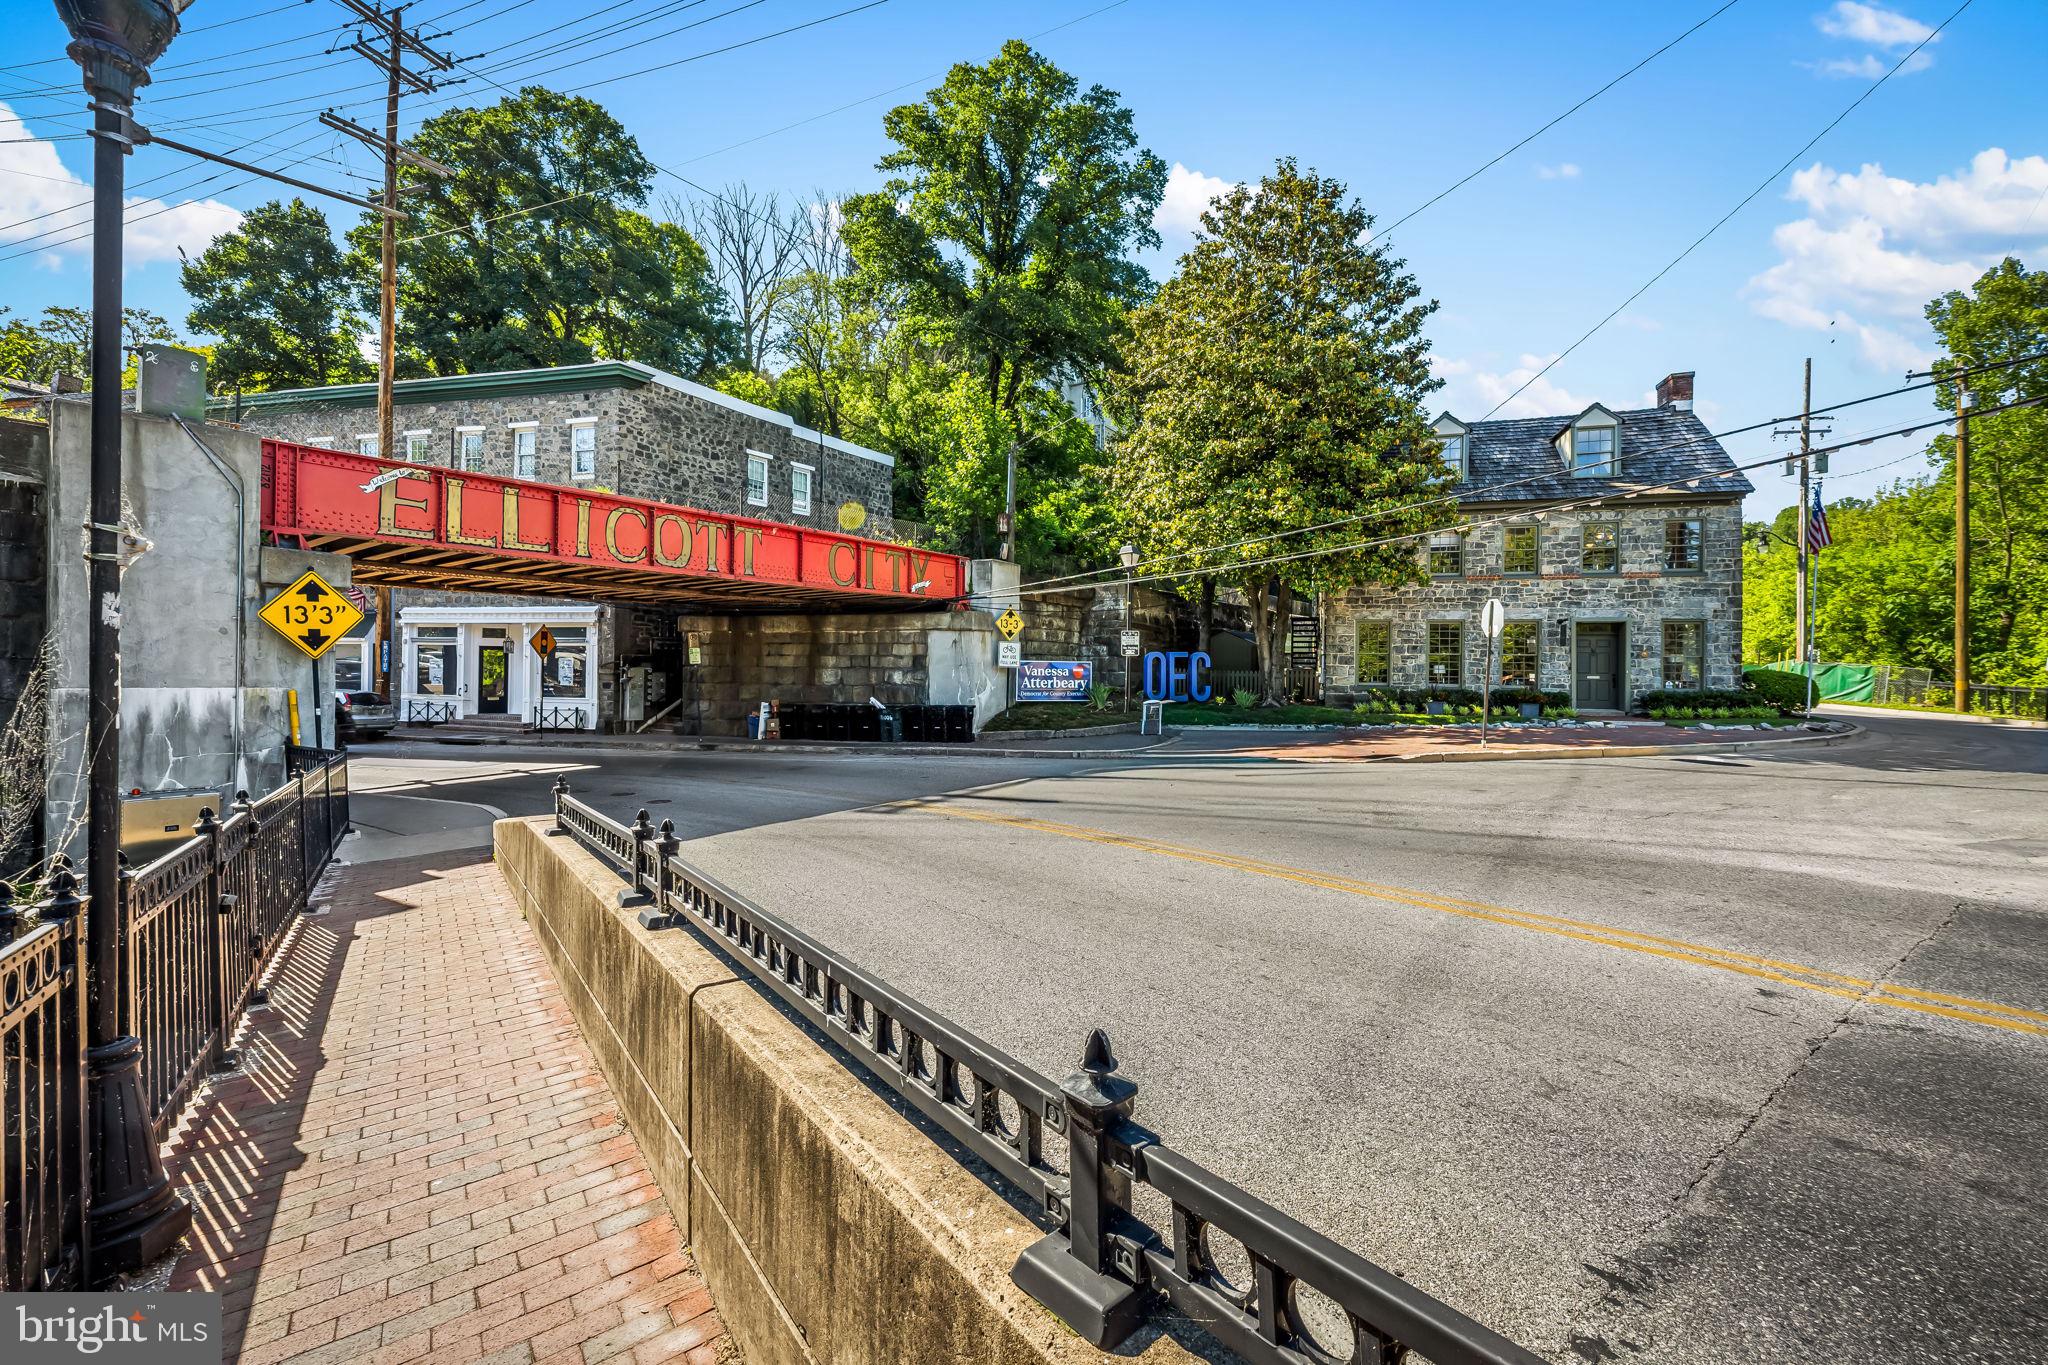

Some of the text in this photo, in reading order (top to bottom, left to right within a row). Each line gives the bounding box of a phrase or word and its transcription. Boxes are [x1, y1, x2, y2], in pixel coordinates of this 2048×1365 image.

[375, 466, 931, 595] ELLICOTT CITY
[1023, 665, 1069, 676] Vanessa
[1144, 651, 1212, 702] OEC
[1020, 677, 1088, 691] Atterbeary
[1020, 690, 1041, 698] Democrat
